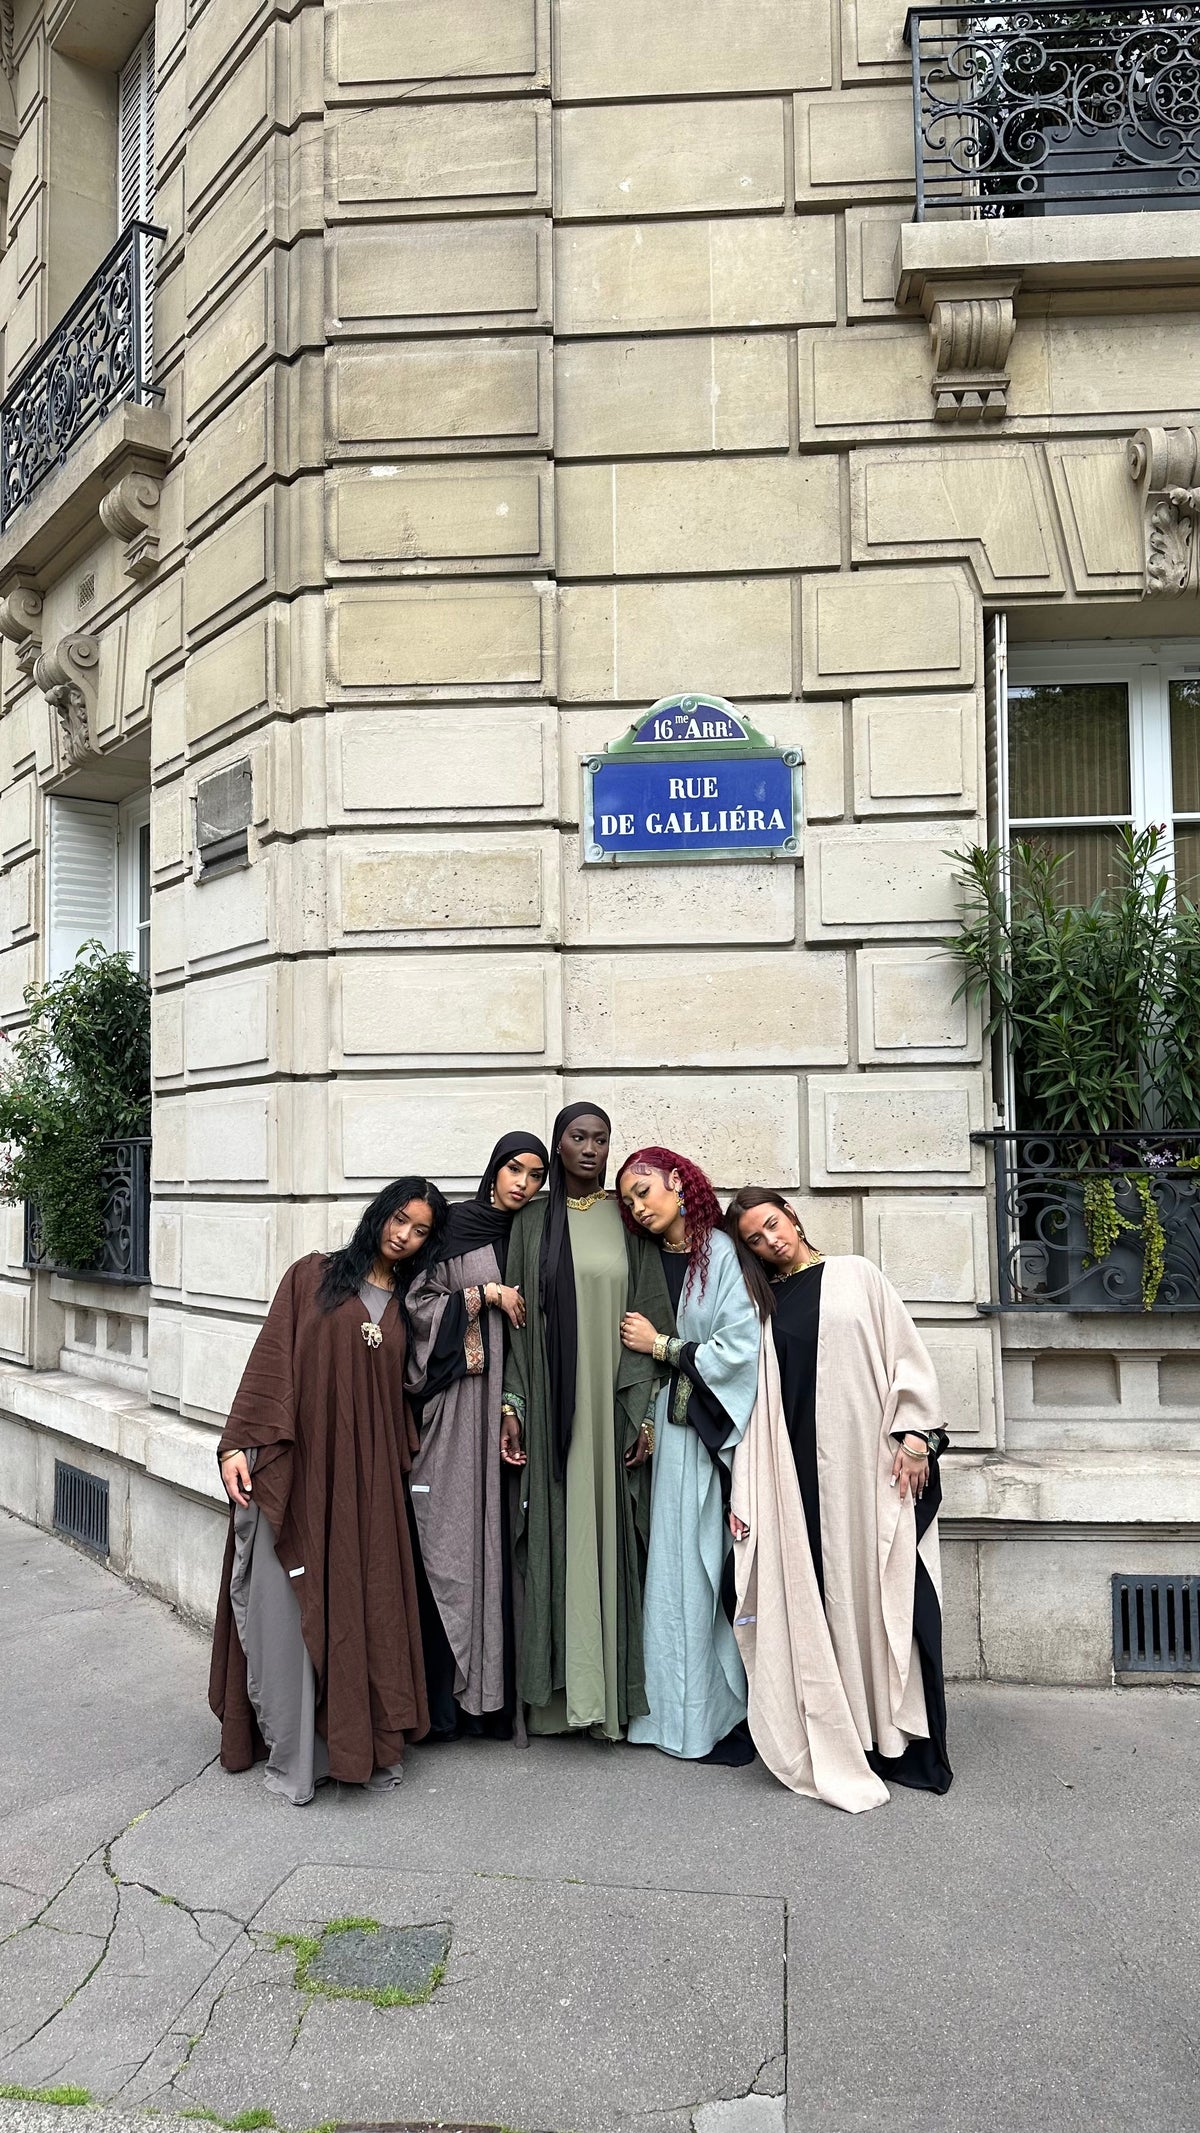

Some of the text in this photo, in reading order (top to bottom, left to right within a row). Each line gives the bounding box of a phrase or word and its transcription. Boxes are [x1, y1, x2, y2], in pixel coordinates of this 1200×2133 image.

[669, 777, 718, 799] RUE
[601, 805, 786, 836] DE GALLIÉRA
